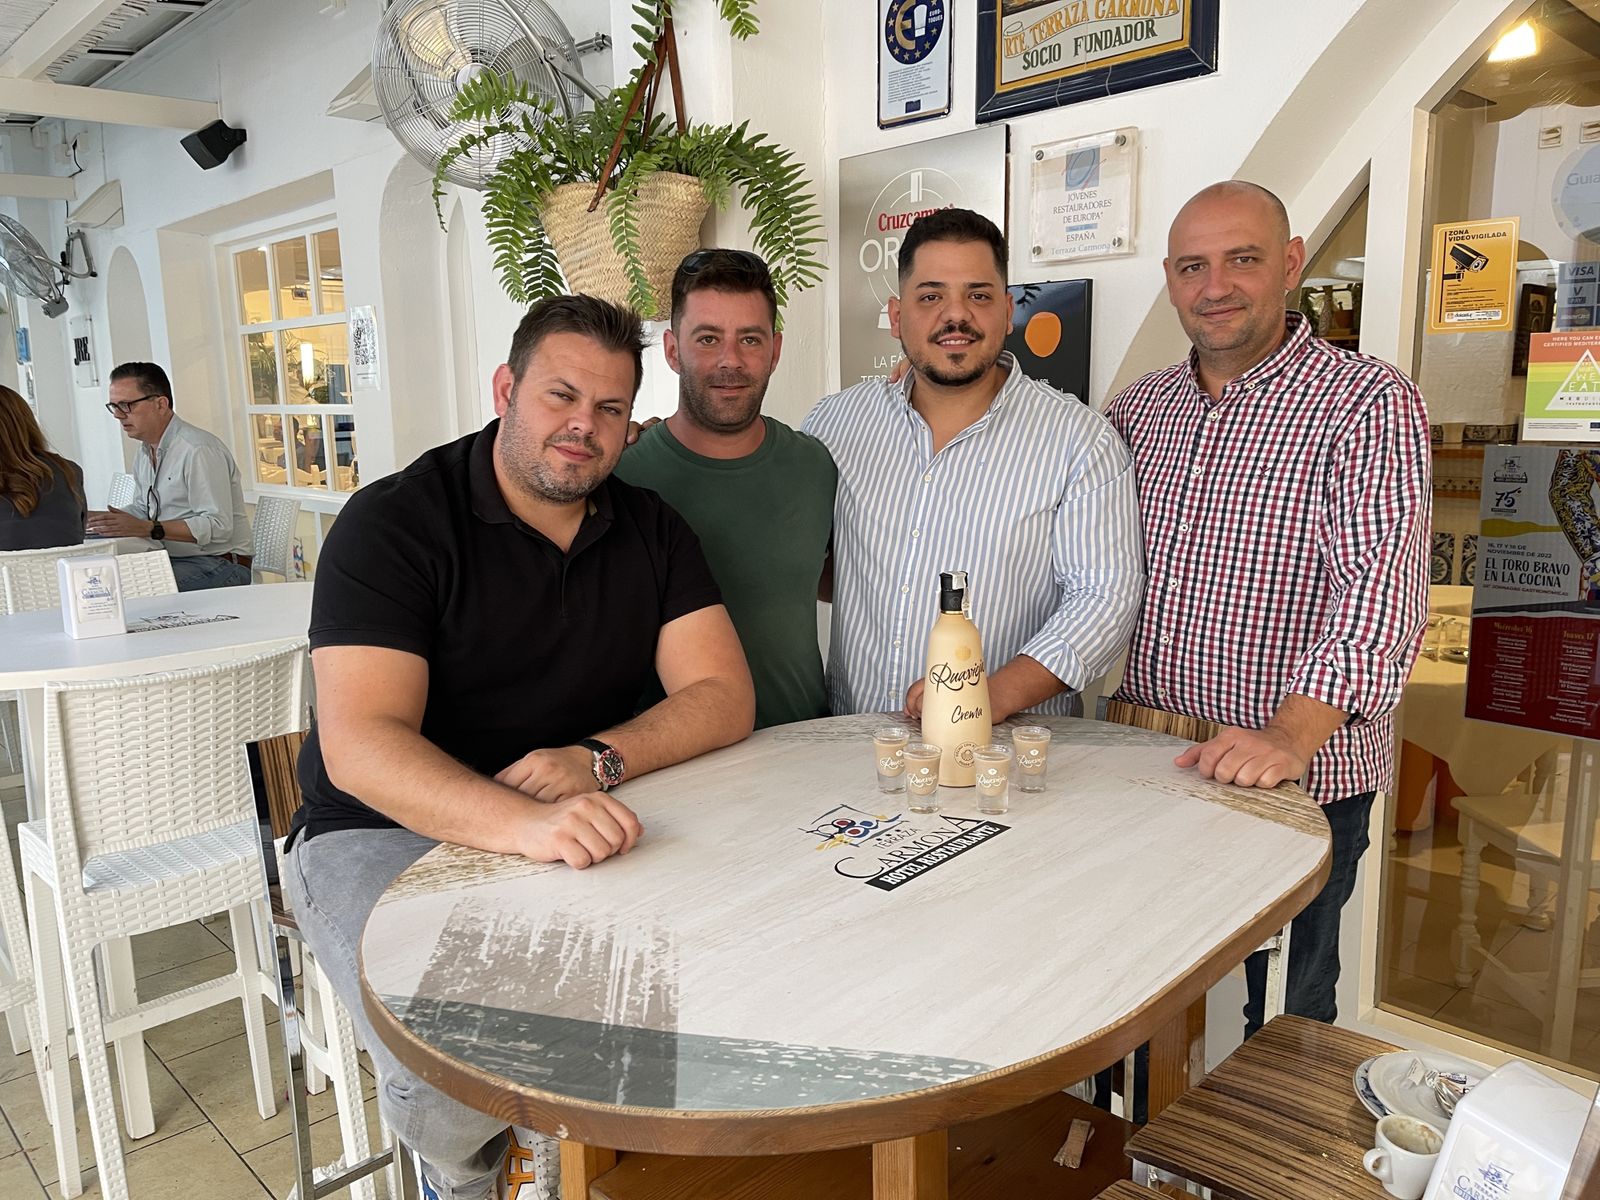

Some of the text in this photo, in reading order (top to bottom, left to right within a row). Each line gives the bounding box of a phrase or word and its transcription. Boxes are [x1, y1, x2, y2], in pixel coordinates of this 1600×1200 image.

[1030, 0, 1090, 46] TERRAZA
[1094, 0, 1180, 19] CARMONA
[1022, 19, 1158, 71] SOCIO FUNDADOR
[1053, 199, 1112, 215] RESTAURADORES
[1066, 231, 1096, 242] ESPAÑA
[1448, 231, 1507, 241] VIDEOVIGILADA
[860, 236, 900, 272] OR
[1569, 266, 1594, 276] VISA
[74, 336, 90, 366] JRE
[874, 356, 888, 368] LA
[1487, 549, 1525, 557] NOVIEMBRE
[1485, 557, 1570, 576] EL TORO BRAVO
[1484, 570, 1561, 588] EN LA COCINA
[951, 705, 983, 724] Crema
[834, 815, 986, 879] CARMONA
[873, 827, 920, 849] TERRAZA
[879, 825, 1001, 885] HOTEL RESTAURANTE
